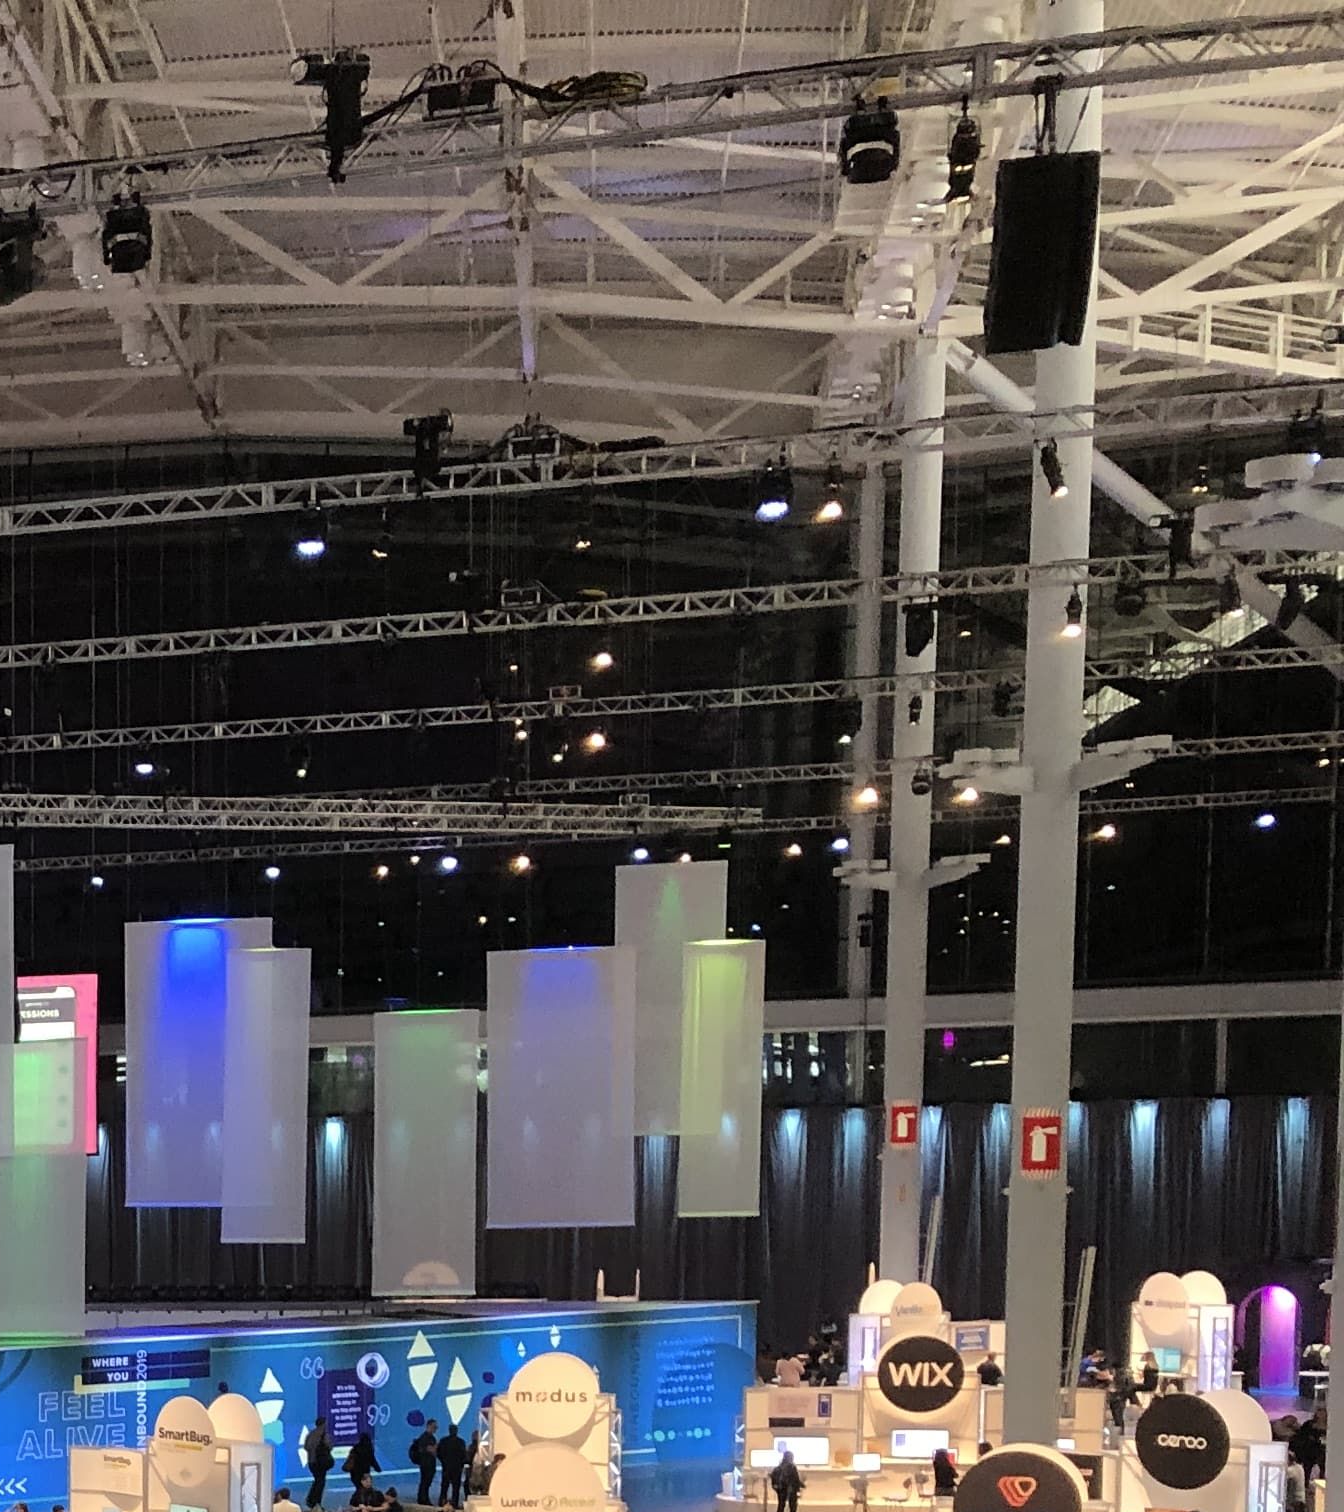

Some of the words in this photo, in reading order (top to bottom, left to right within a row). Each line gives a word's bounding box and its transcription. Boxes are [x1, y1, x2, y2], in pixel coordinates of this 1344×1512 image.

[92, 1357, 129, 1368] WHERE
[107, 1372, 129, 1382] YOU
[888, 1362, 954, 1388] WIX
[515, 1388, 587, 1402] modus
[39, 1391, 126, 1422] FEEL
[16, 1423, 125, 1461] ALIVE
[500, 1497, 539, 1508] Writer
